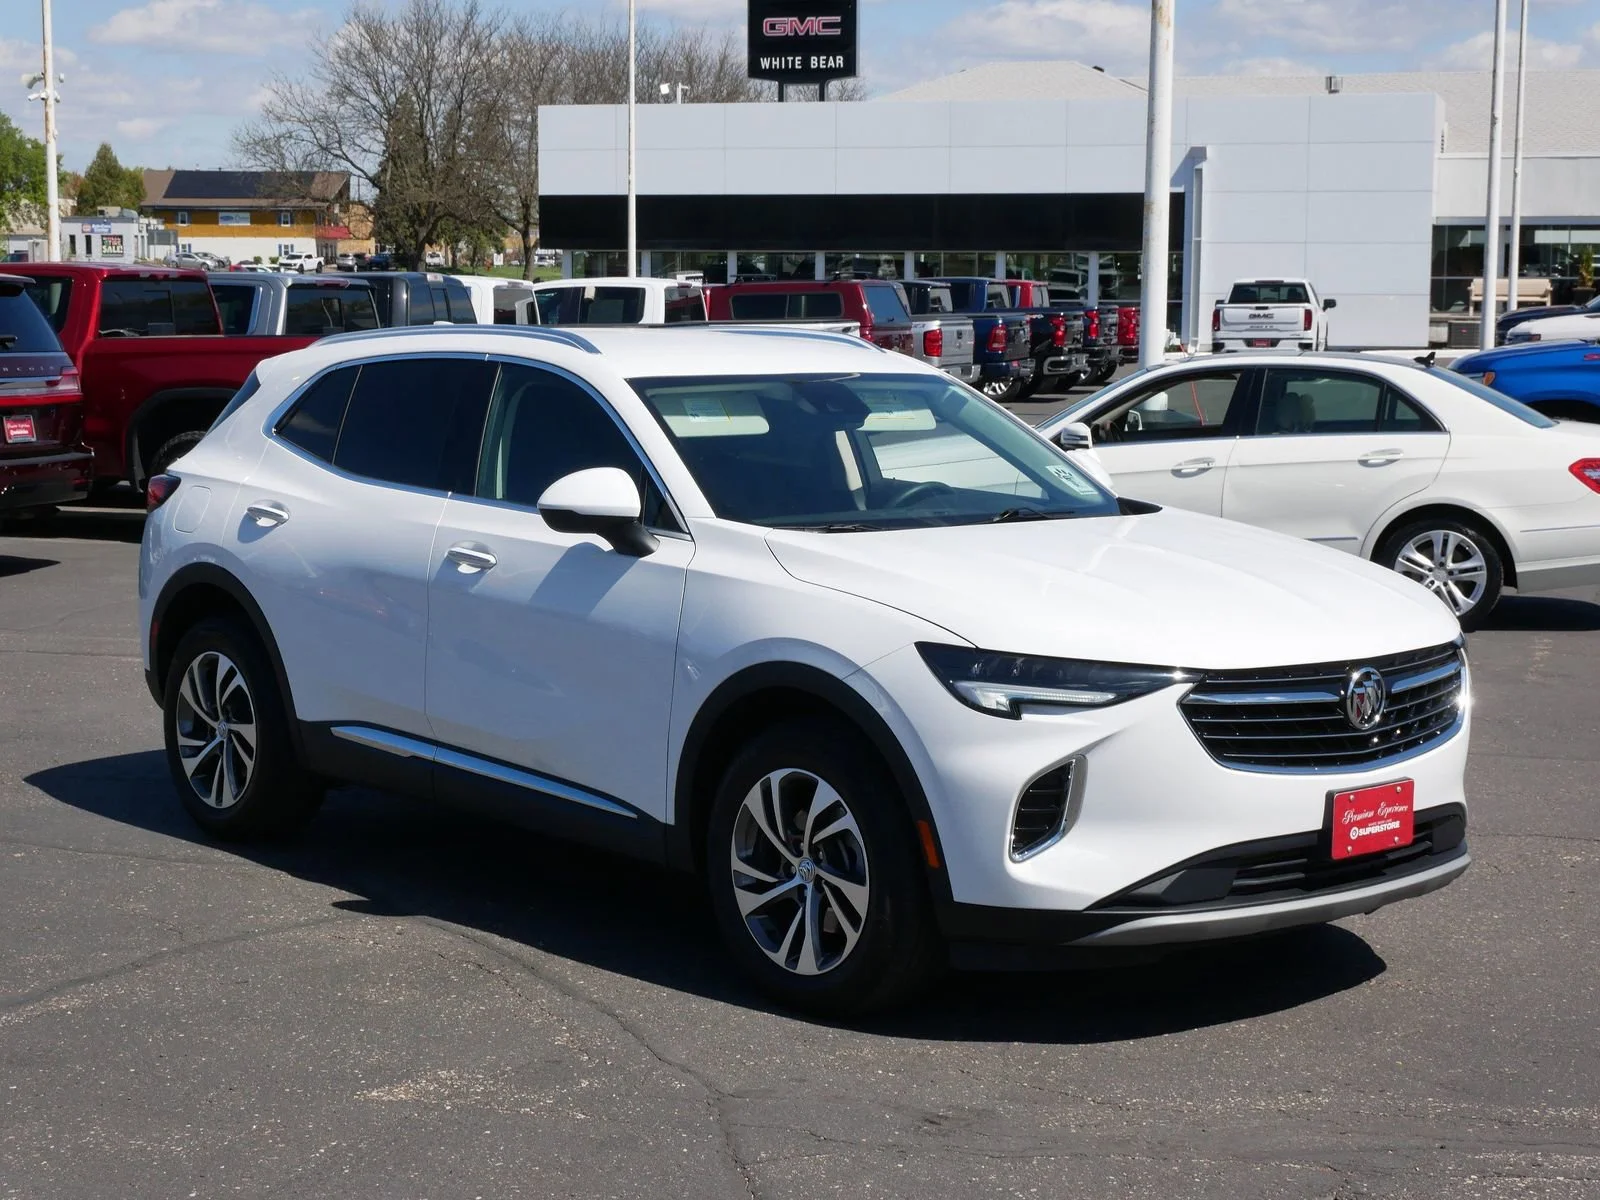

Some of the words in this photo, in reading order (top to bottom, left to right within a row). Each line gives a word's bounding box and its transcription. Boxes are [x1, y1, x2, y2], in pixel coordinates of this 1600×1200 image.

[763, 16, 842, 36] GMC
[760, 56, 802, 69] WHITE
[811, 56, 844, 69] BEAR
[1358, 821, 1400, 836] SUPERSTORE
